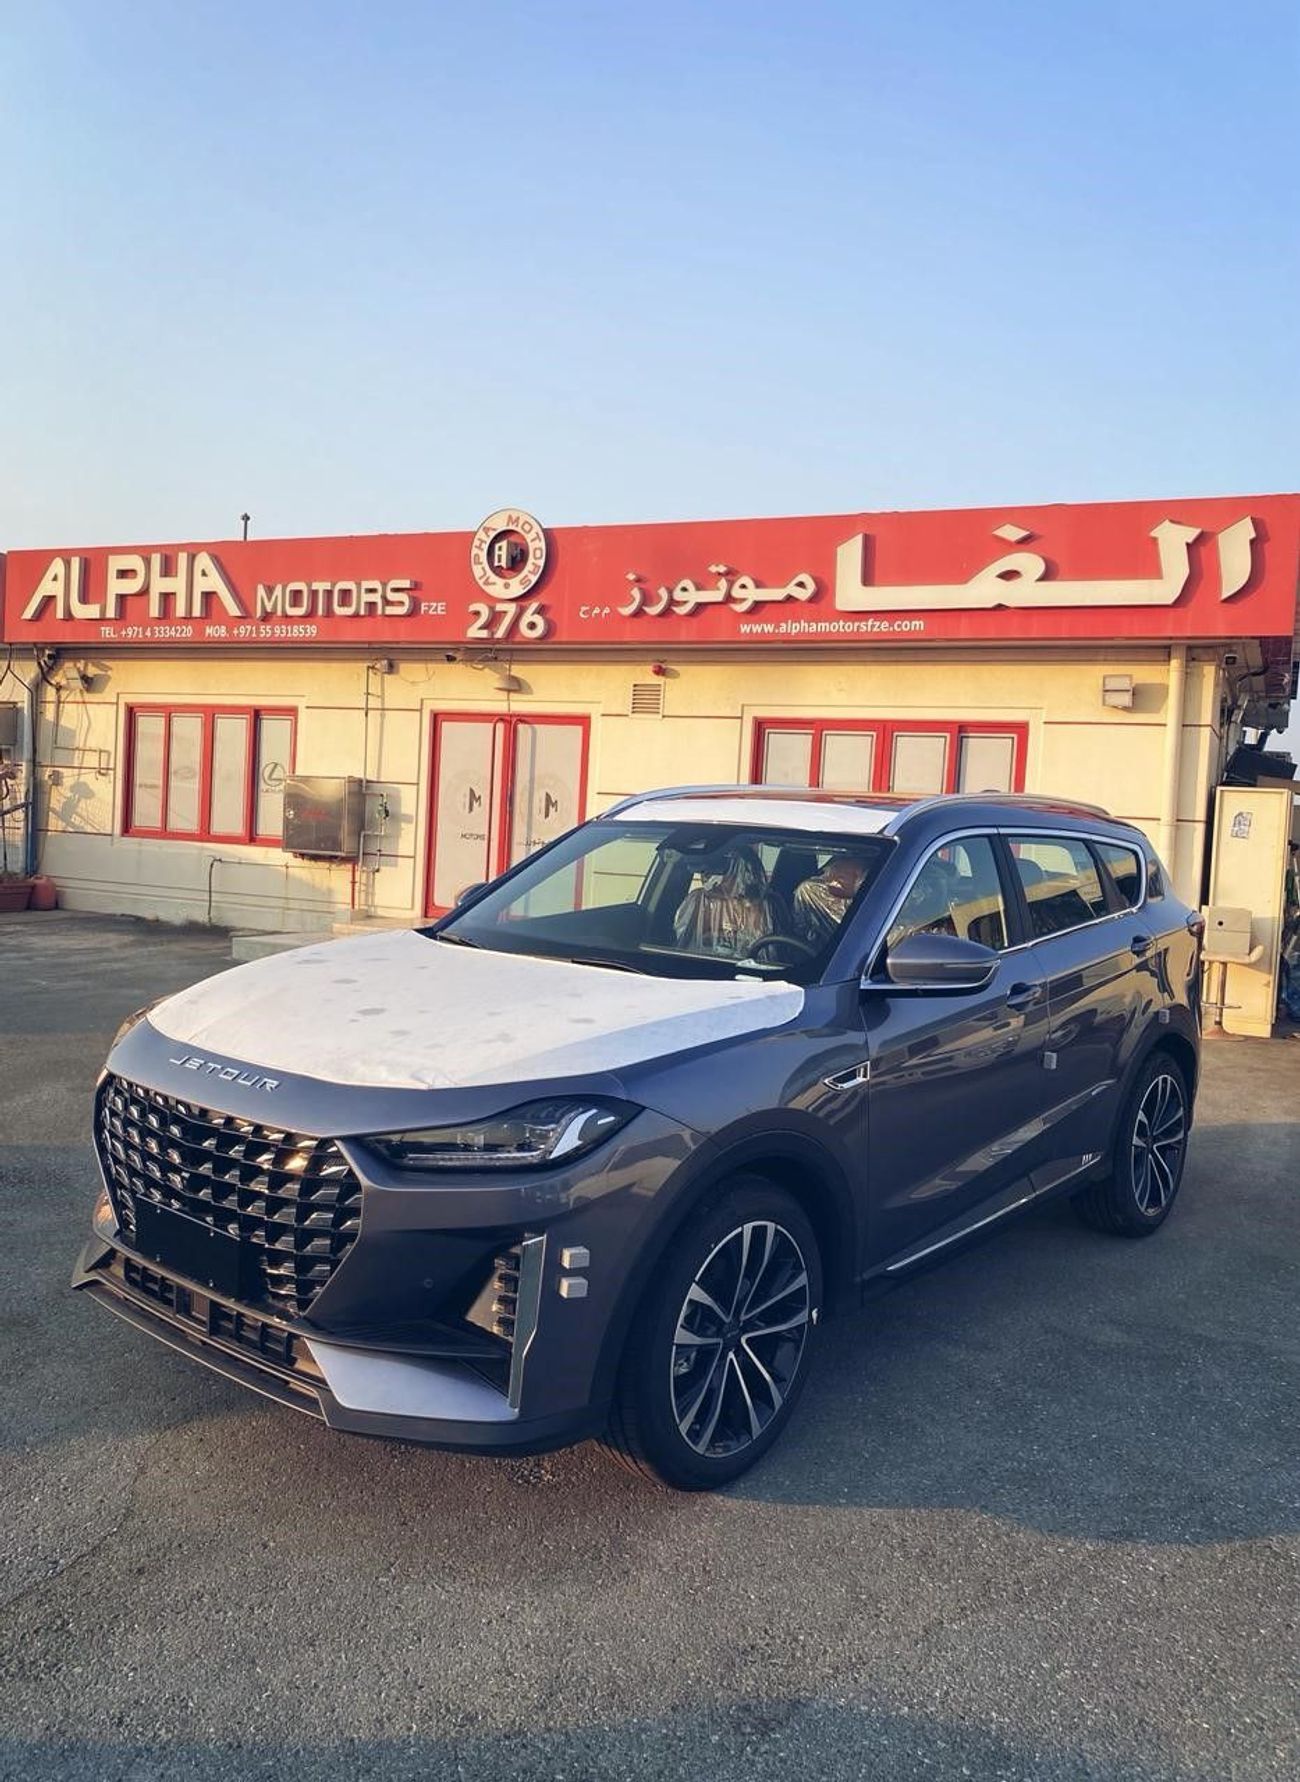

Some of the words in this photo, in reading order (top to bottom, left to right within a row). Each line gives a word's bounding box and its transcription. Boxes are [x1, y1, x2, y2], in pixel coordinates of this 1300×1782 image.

[473, 526, 497, 586] ALPHA
[506, 514, 543, 590] MOTORS
[20, 551, 244, 620] ALPHA
[255, 579, 413, 619] MOTORS
[420, 602, 447, 615] FZE
[617, 563, 818, 616] موتورز
[100, 626, 118, 638] TEL.
[120, 626, 143, 638] +971
[144, 626, 152, 638] 4
[153, 625, 193, 638] 3334220
[205, 625, 229, 638] MOB.
[233, 625, 257, 638] +971
[259, 625, 272, 637] 55
[274, 624, 317, 638] 9318539
[466, 602, 545, 639] 276
[740, 618, 925, 636] www.alphamotorsfze.com
[169, 1055, 280, 1093] JETOUR
